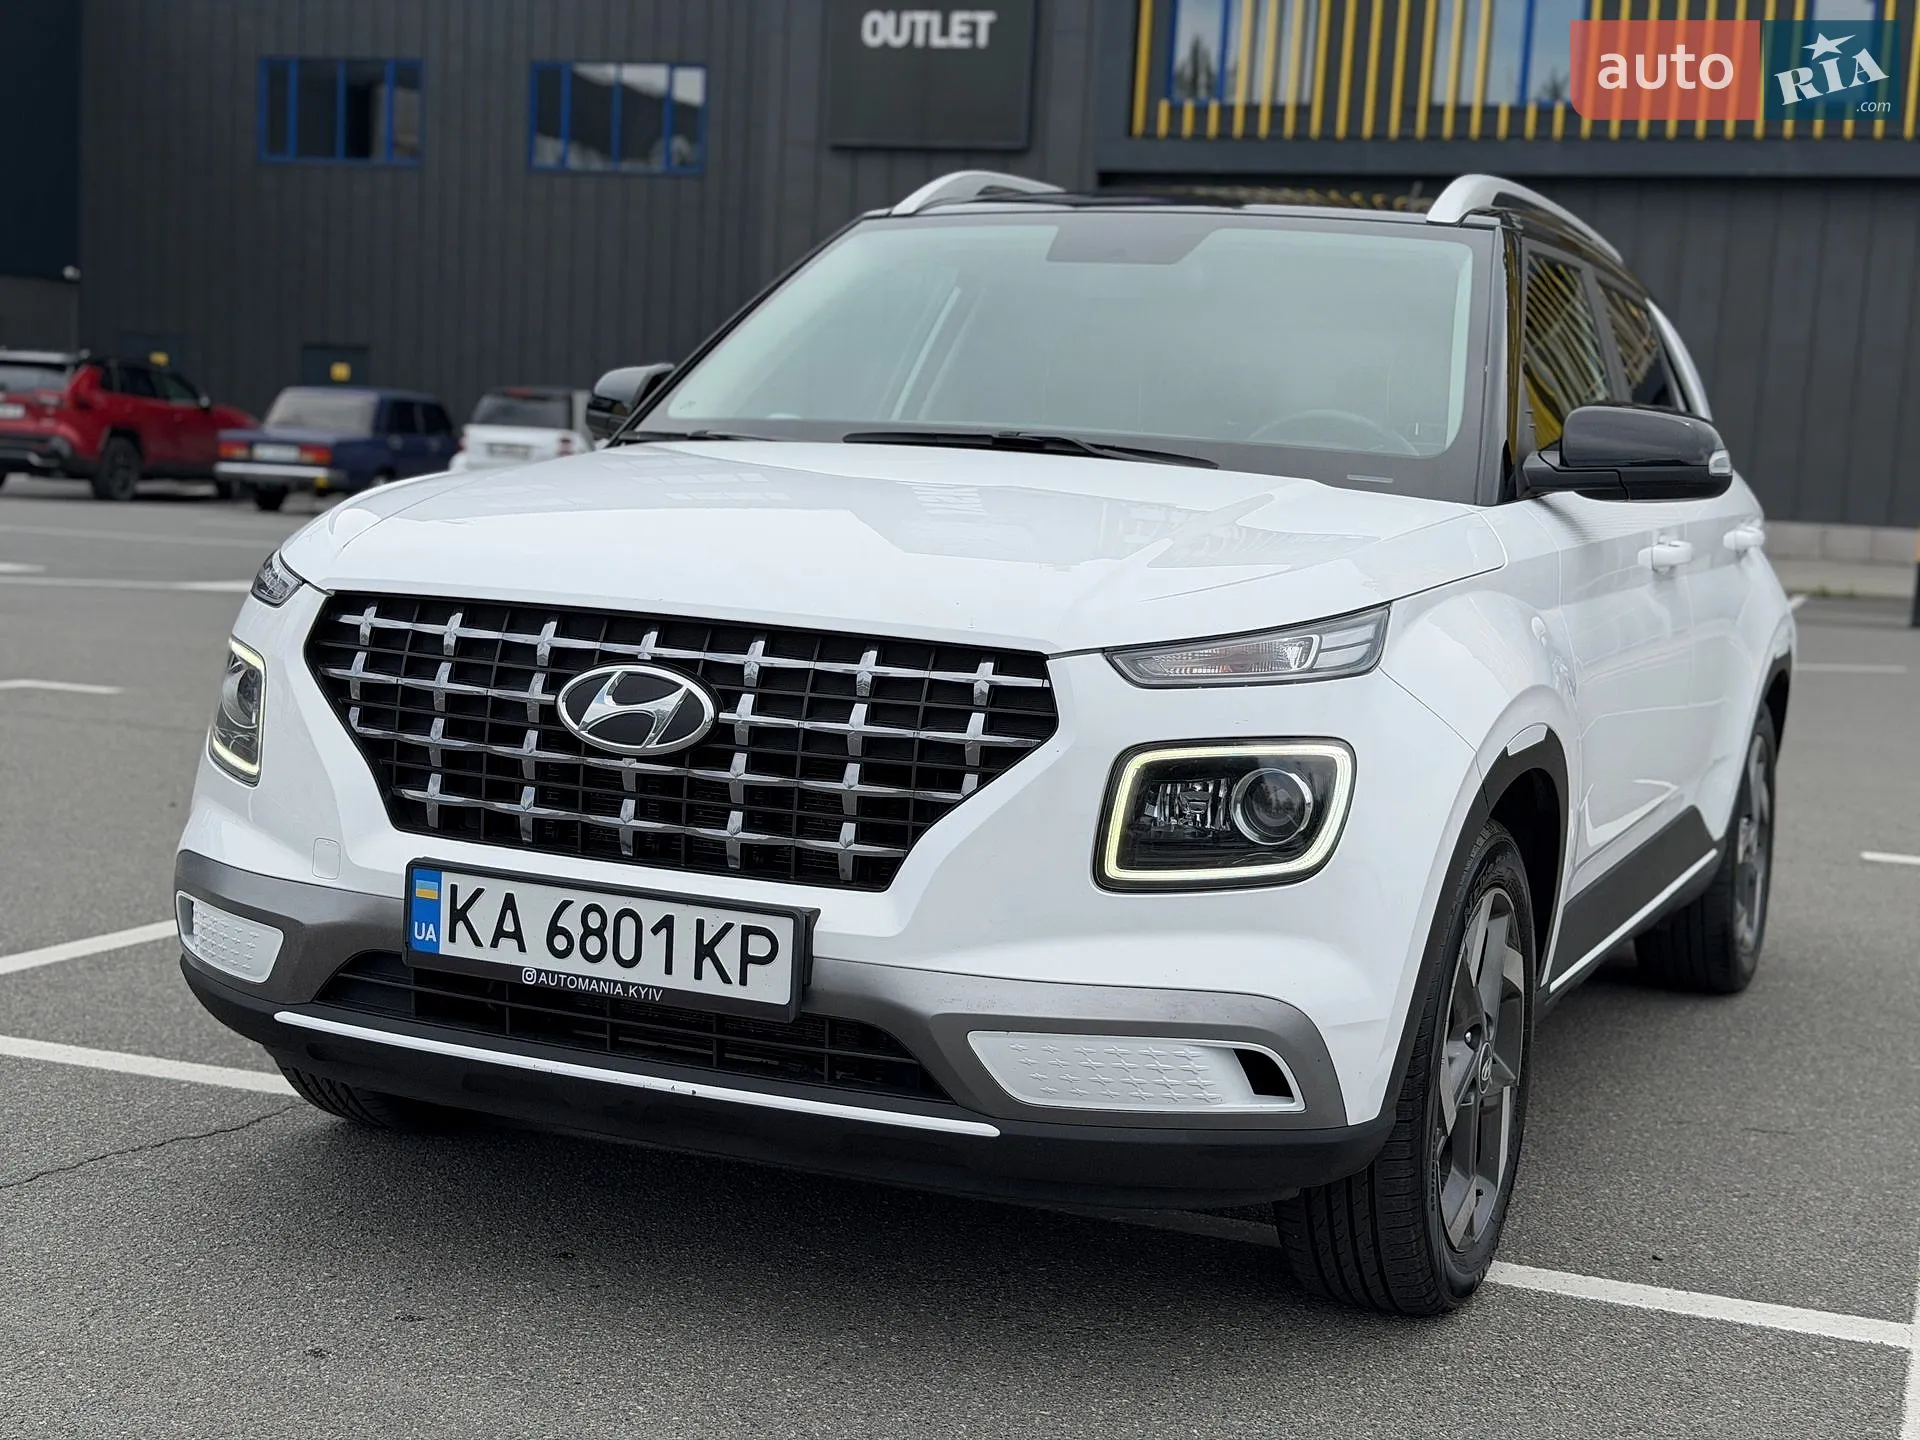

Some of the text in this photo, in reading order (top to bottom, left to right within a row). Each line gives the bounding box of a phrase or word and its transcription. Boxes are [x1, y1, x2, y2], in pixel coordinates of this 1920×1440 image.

[861, 10, 997, 49] OUTLET
[414, 921, 437, 942] UA
[447, 883, 780, 987] KA 6801 KP
[538, 971, 663, 1002] AUTOMANIA.KYIV
